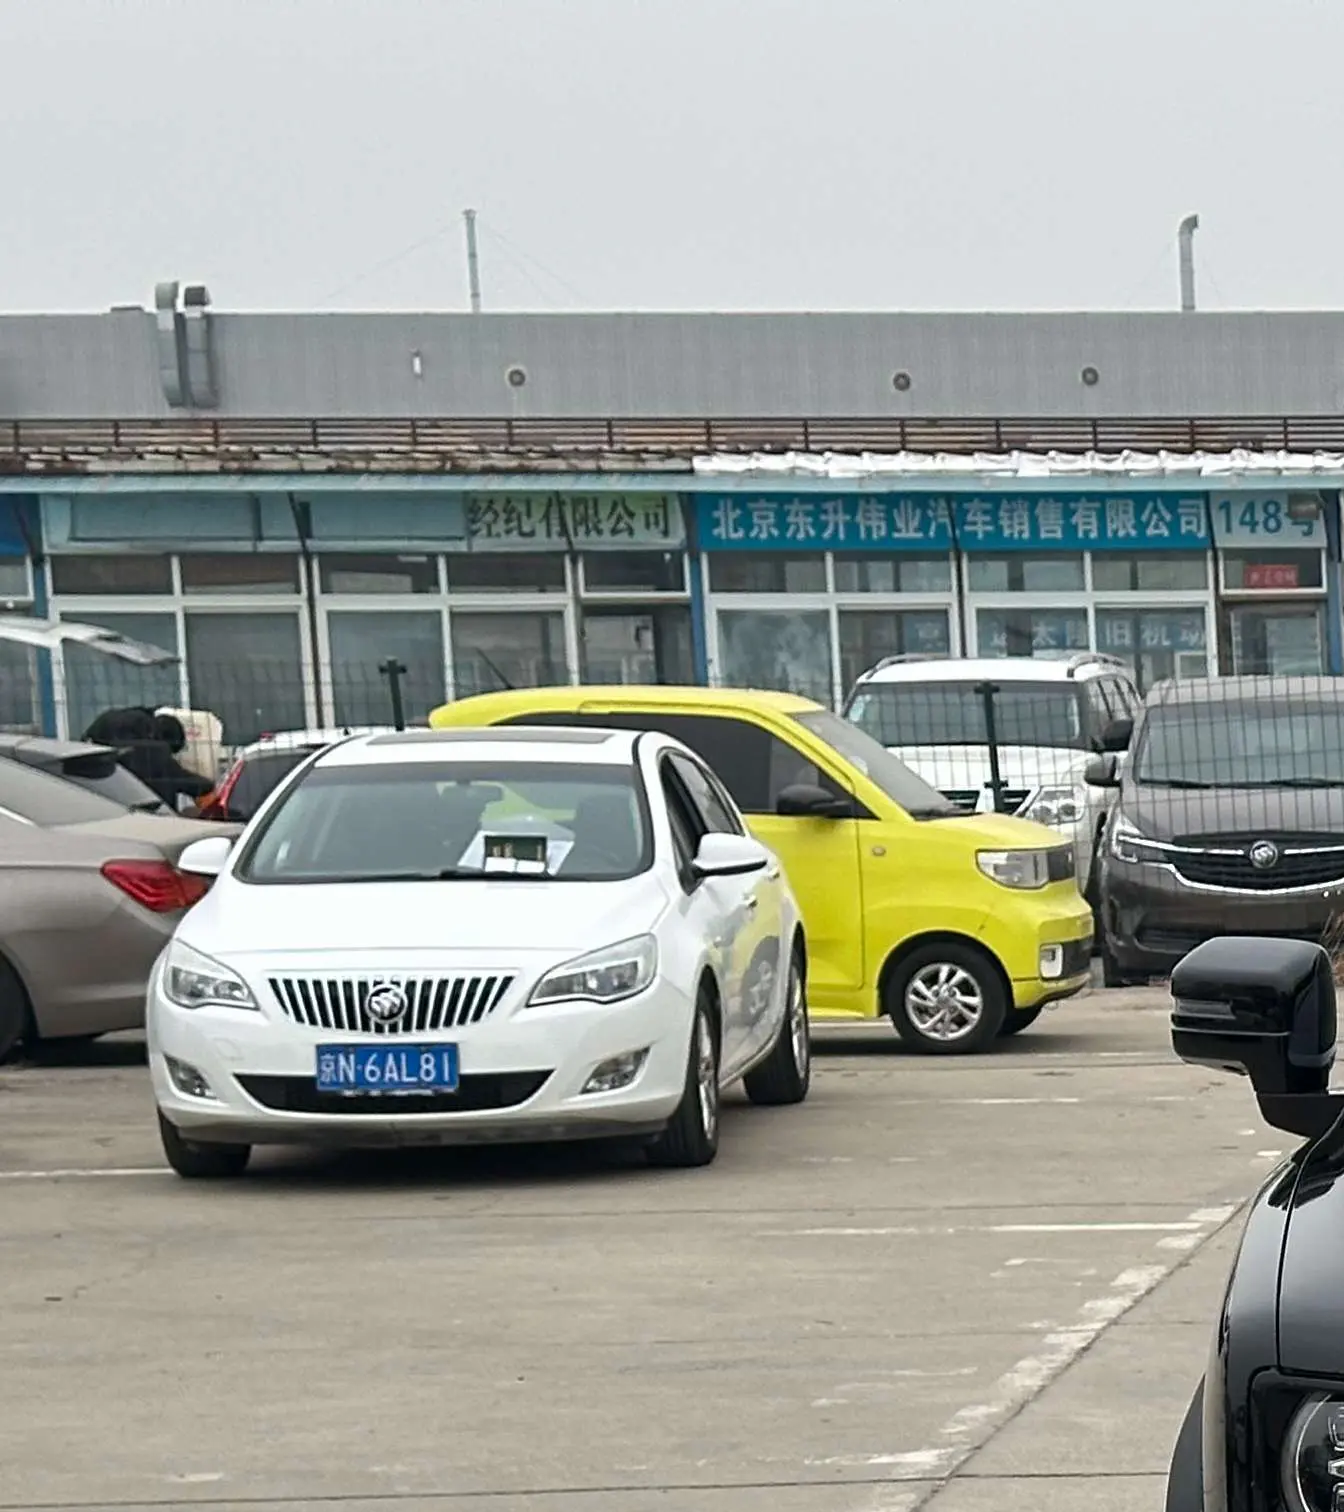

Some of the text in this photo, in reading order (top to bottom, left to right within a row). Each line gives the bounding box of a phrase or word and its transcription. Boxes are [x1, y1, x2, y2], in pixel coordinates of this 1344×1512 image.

[466, 494, 670, 539] 经纪有限公司
[711, 496, 1207, 541] 北京东升伟业汽车销售有限公司
[319, 1051, 450, 1083] 京N·6AL81
